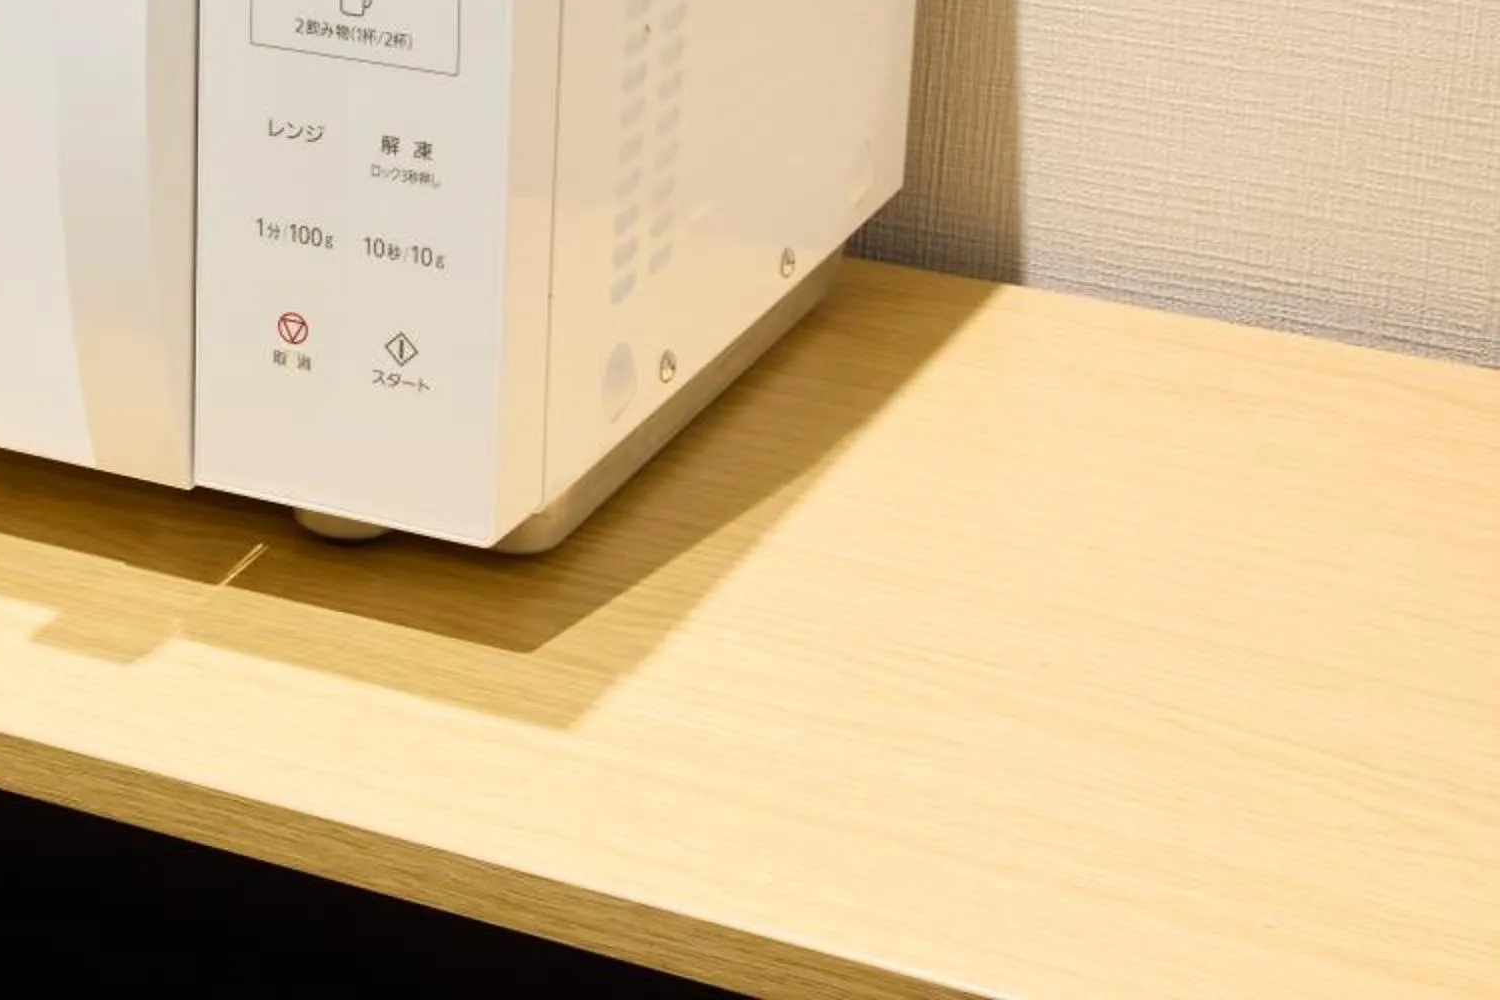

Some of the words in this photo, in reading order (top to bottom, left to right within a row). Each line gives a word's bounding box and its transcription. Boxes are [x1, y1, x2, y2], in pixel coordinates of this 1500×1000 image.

[268, 118, 325, 142] レンジ
[372, 369, 430, 392] スタート
